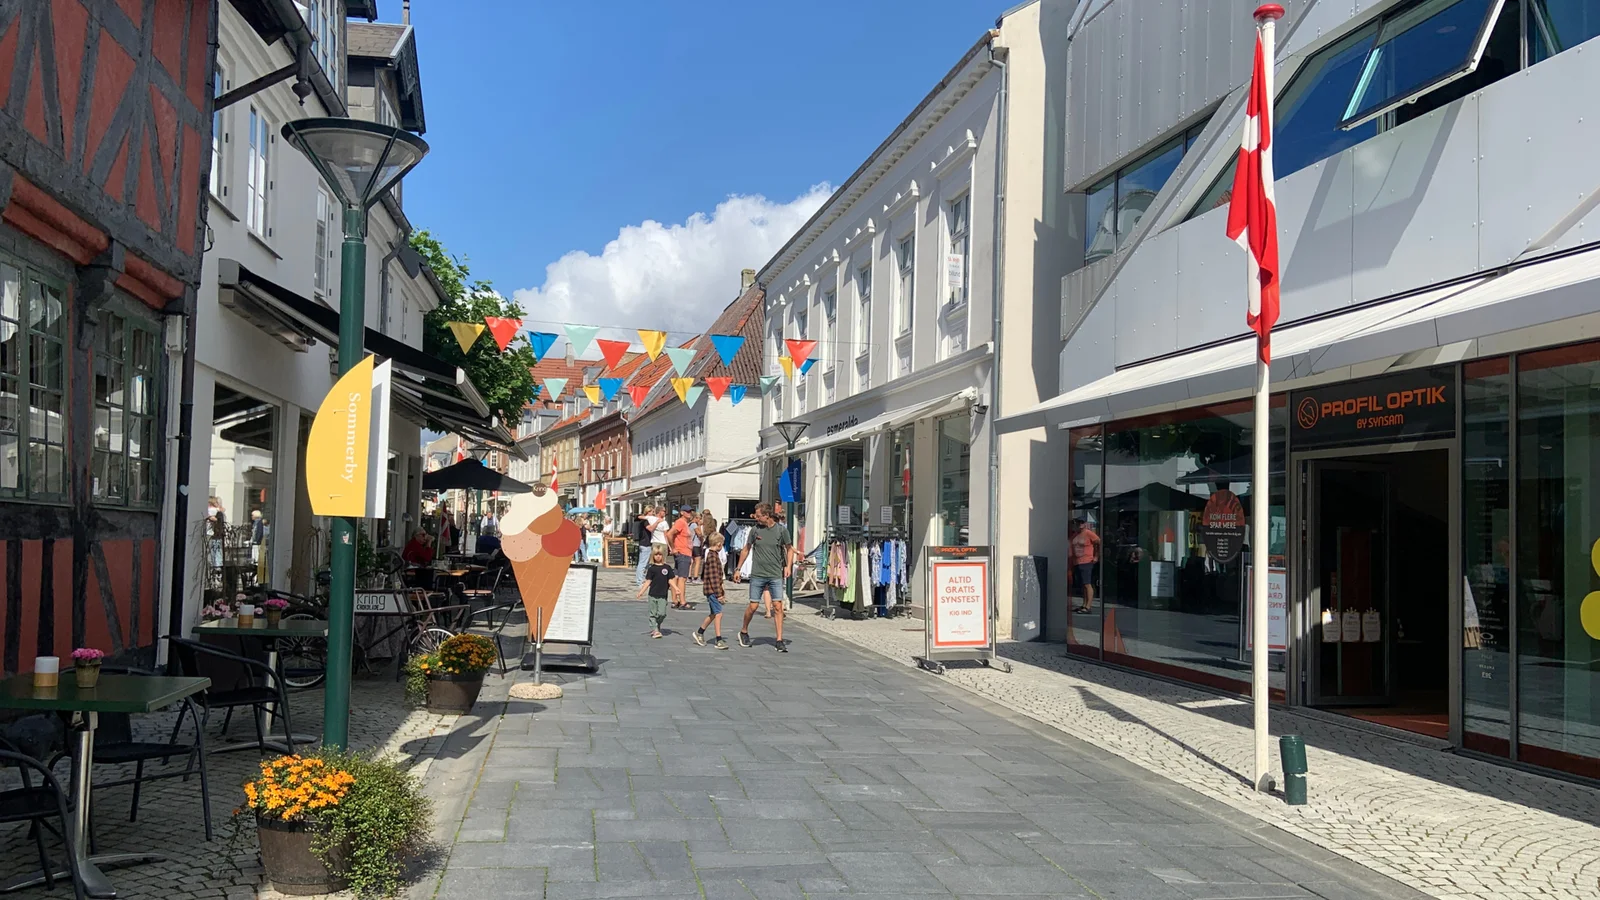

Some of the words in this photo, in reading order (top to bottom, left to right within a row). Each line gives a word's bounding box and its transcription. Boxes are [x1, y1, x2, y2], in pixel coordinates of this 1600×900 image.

[1321, 395, 1383, 417] PROFIL
[1386, 385, 1446, 409] OPTIK
[826, 414, 859, 437] esmeralda
[1356, 419, 1368, 429] BY
[1368, 414, 1404, 428] SYNSAM
[341, 392, 361, 483] Sommerby
[1209, 513, 1221, 521] KOM
[1222, 513, 1237, 521] FLERE
[1209, 521, 1221, 529] SPAR
[948, 576, 972, 584] ALTID
[945, 585, 975, 594] GRATIS
[356, 593, 386, 610] Kring
[940, 595, 980, 604] SYNSTEST
